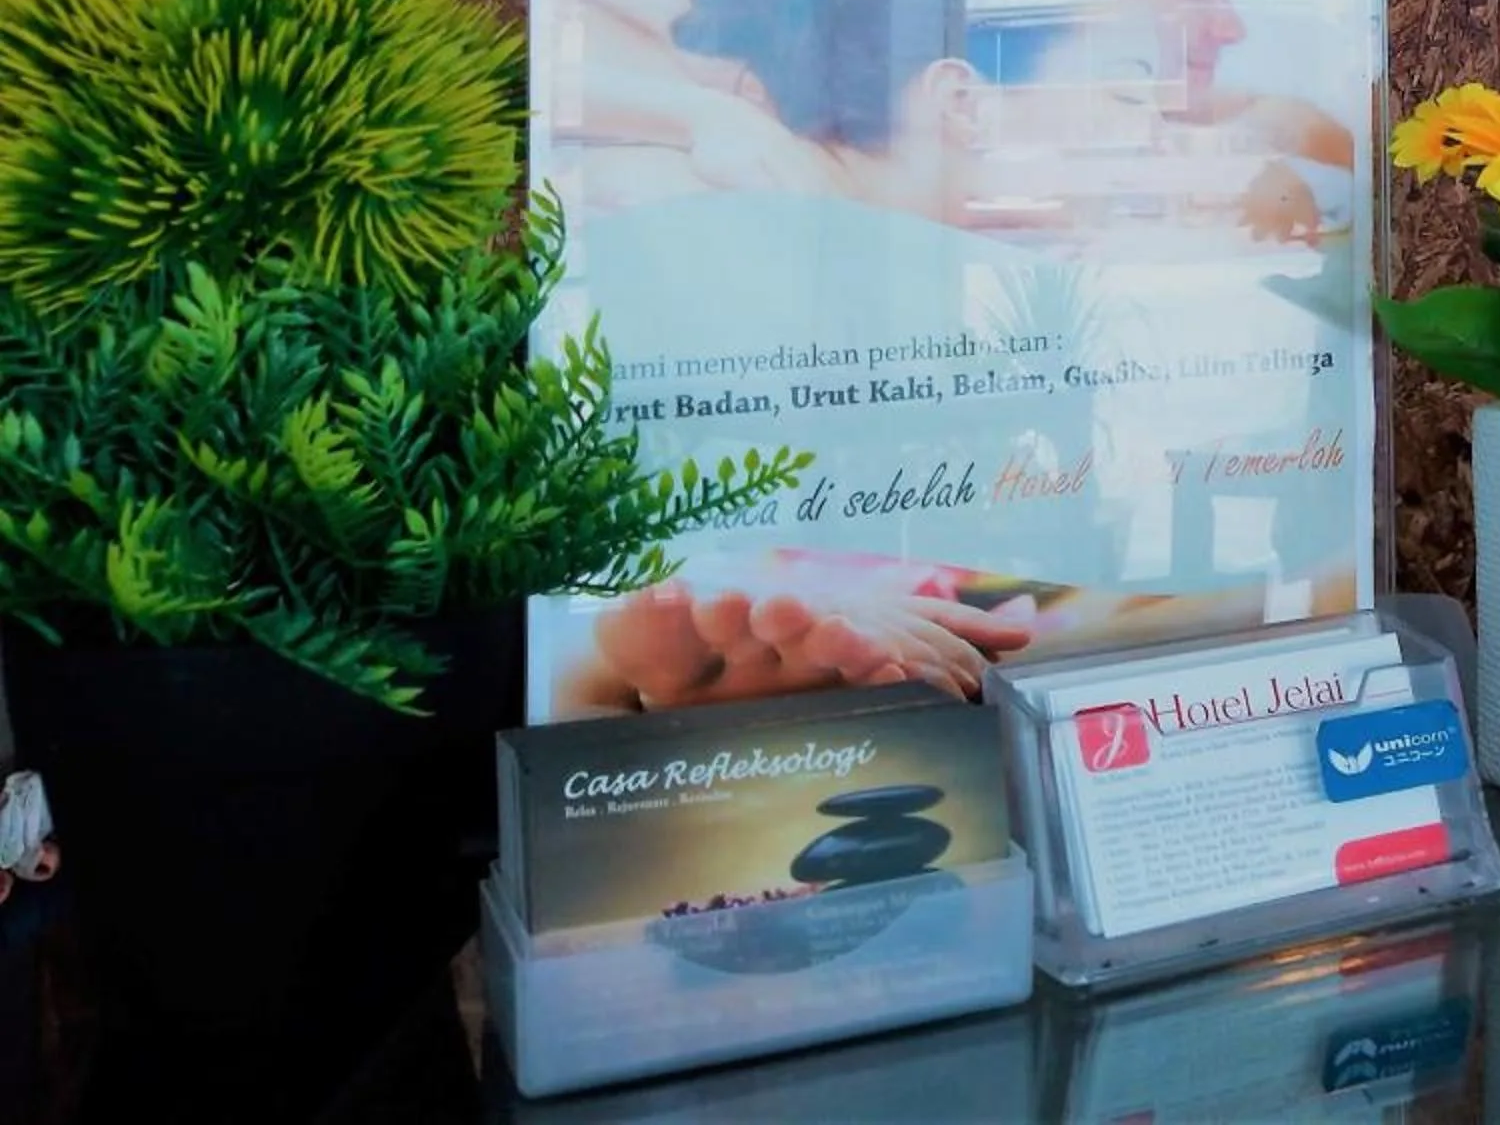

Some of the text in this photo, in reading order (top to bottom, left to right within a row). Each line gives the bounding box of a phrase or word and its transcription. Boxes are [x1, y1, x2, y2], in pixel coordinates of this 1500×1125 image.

[604, 354, 667, 381] ami
[676, 342, 860, 379] menyediakan
[675, 390, 781, 418] Badan,
[790, 384, 861, 411] Urut
[868, 375, 944, 405] Kaki,
[952, 370, 1055, 397] Bekam,
[796, 476, 835, 523] di
[842, 460, 976, 519] sebelah
[1148, 672, 1345, 730] Hotel Jelai
[1374, 729, 1450, 753] unicorn
[1383, 746, 1446, 768] ユニコーン
[563, 738, 878, 800] Casa Refleksologi
